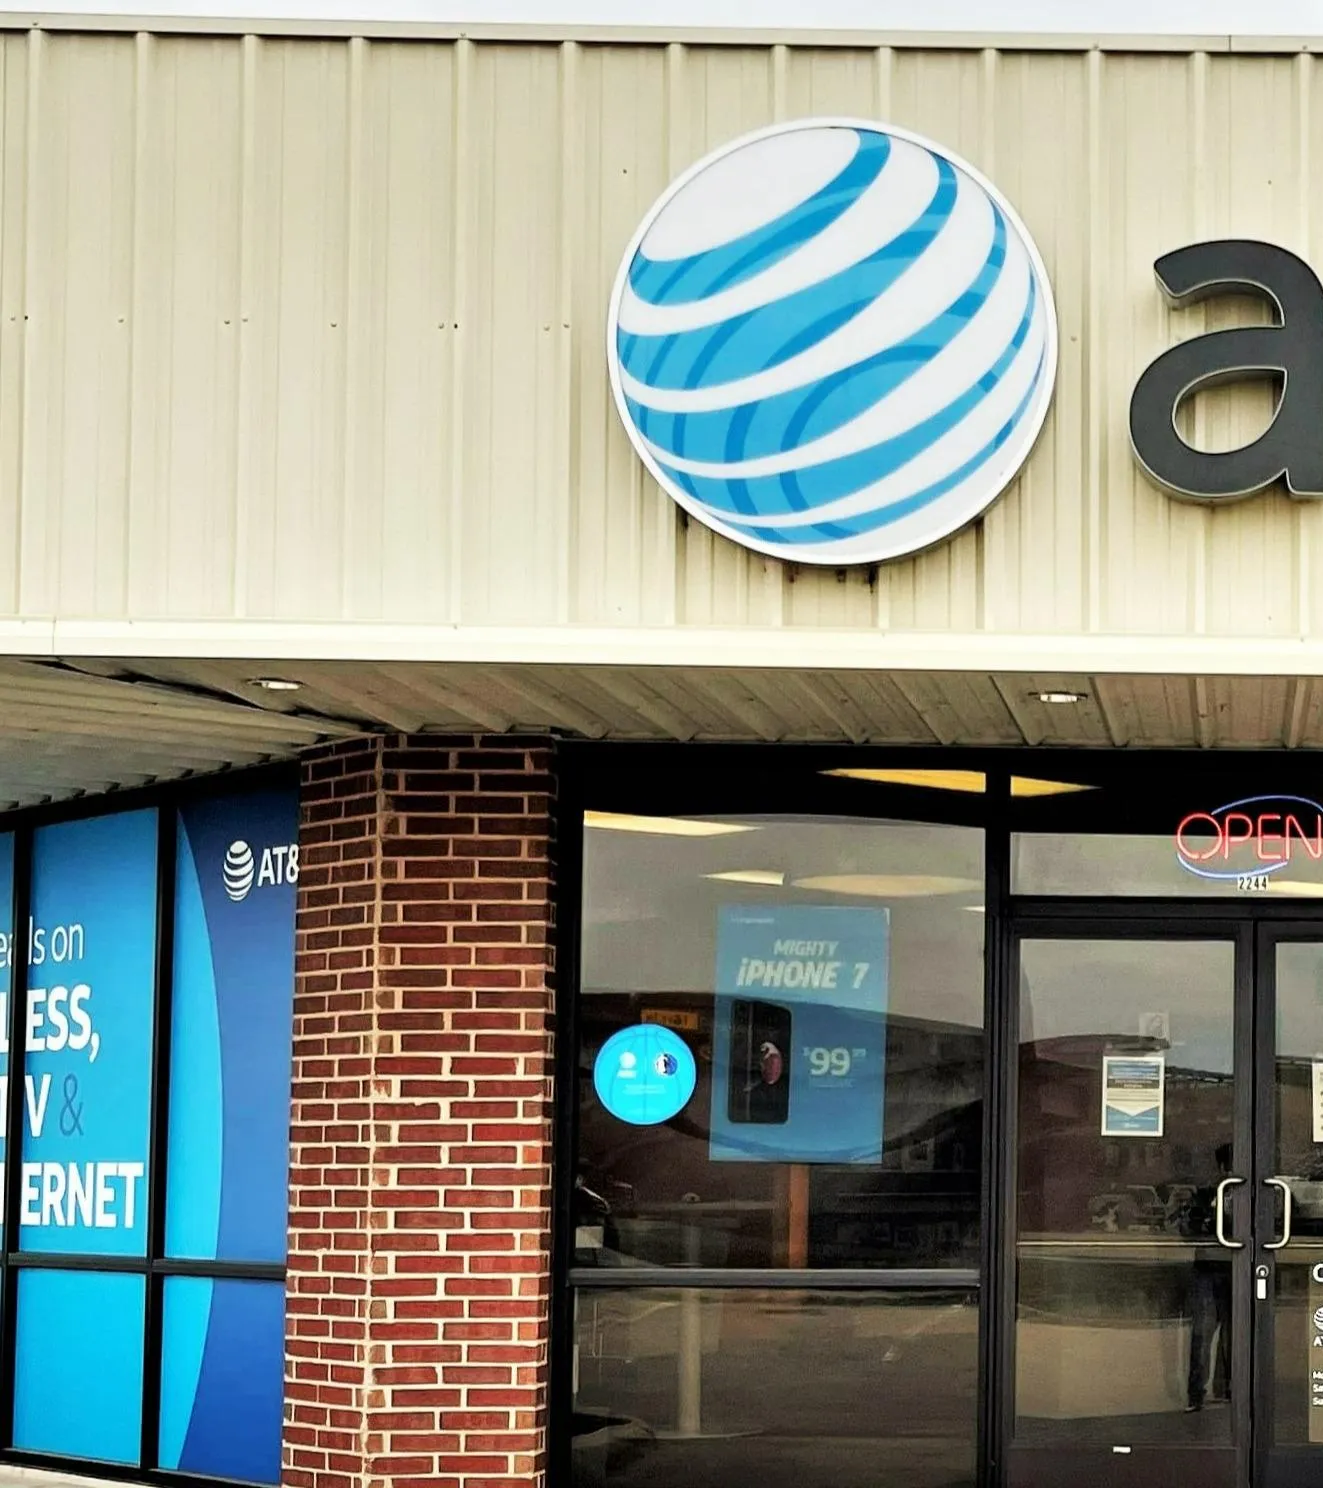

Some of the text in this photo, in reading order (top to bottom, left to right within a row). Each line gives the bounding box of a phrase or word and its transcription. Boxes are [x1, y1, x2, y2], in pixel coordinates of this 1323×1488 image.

[1177, 813, 1323, 861] OPEN
[1238, 876, 1268, 890] 2244
[51, 922, 84, 962] on
[773, 939, 839, 956] MIGHTY
[736, 957, 870, 989] iPHONE 7
[59, 1073, 84, 1136] &
